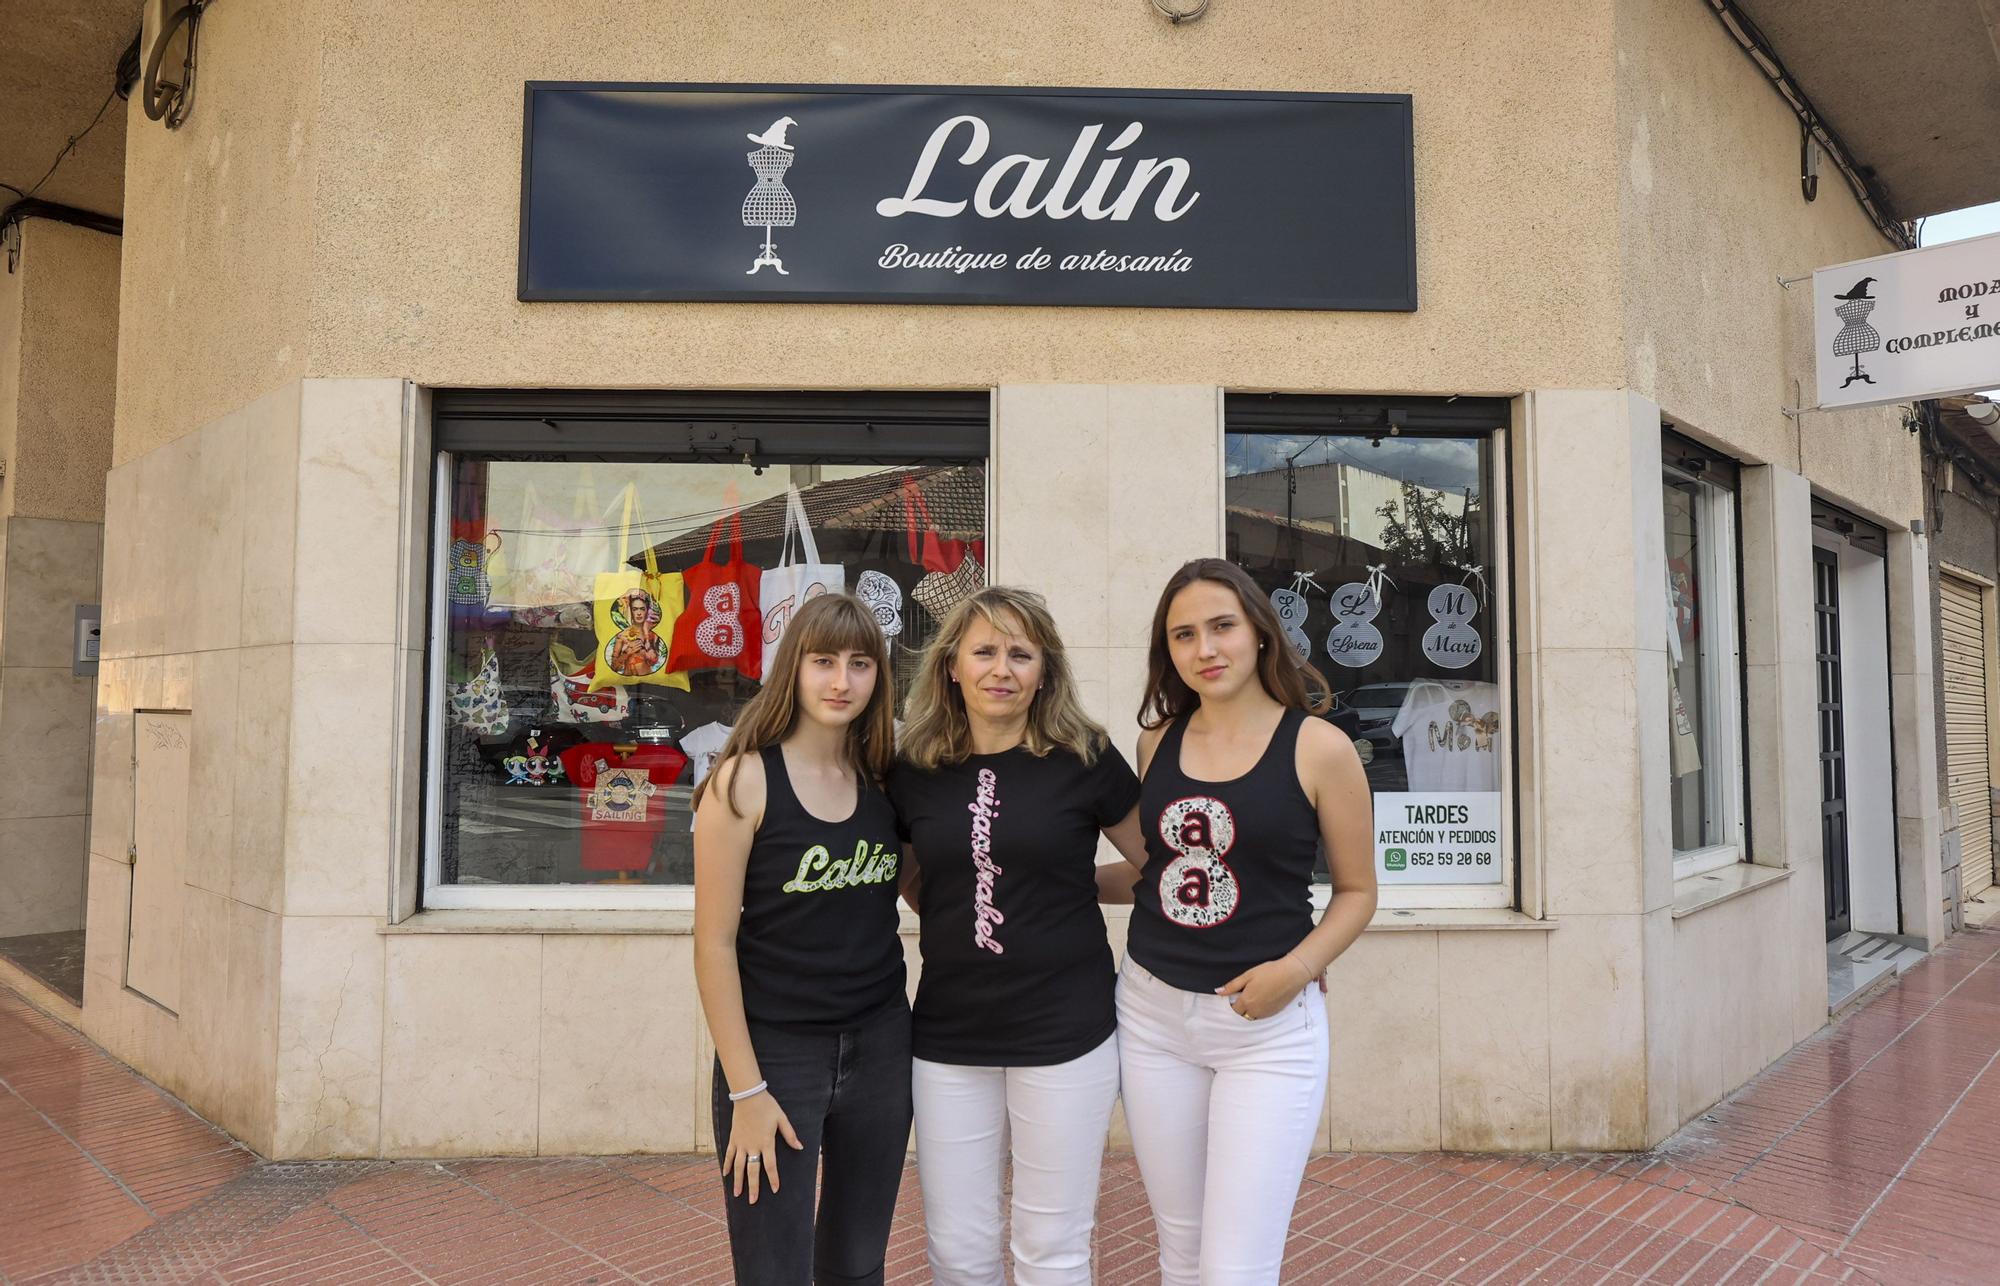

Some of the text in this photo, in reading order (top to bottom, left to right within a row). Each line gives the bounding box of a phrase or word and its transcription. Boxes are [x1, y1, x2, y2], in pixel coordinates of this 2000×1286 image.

[875, 115, 1201, 222] Lalín
[877, 244, 1194, 274] Boutique de artesanía
[1340, 589, 1371, 616] L
[1435, 592, 1467, 615] M
[1331, 634, 1379, 654] Lorena
[1427, 634, 1477, 654] Mari
[595, 809, 643, 821] SAILING
[1405, 805, 1468, 824] TARDES
[1379, 828, 1496, 843] ATENCIÓN Y PEDIDOS
[782, 840, 898, 893] Lalín
[1411, 853, 1434, 865] 652
[1438, 853, 1453, 865] 59
[1457, 853, 1472, 865] 20
[1476, 853, 1491, 865] 60
